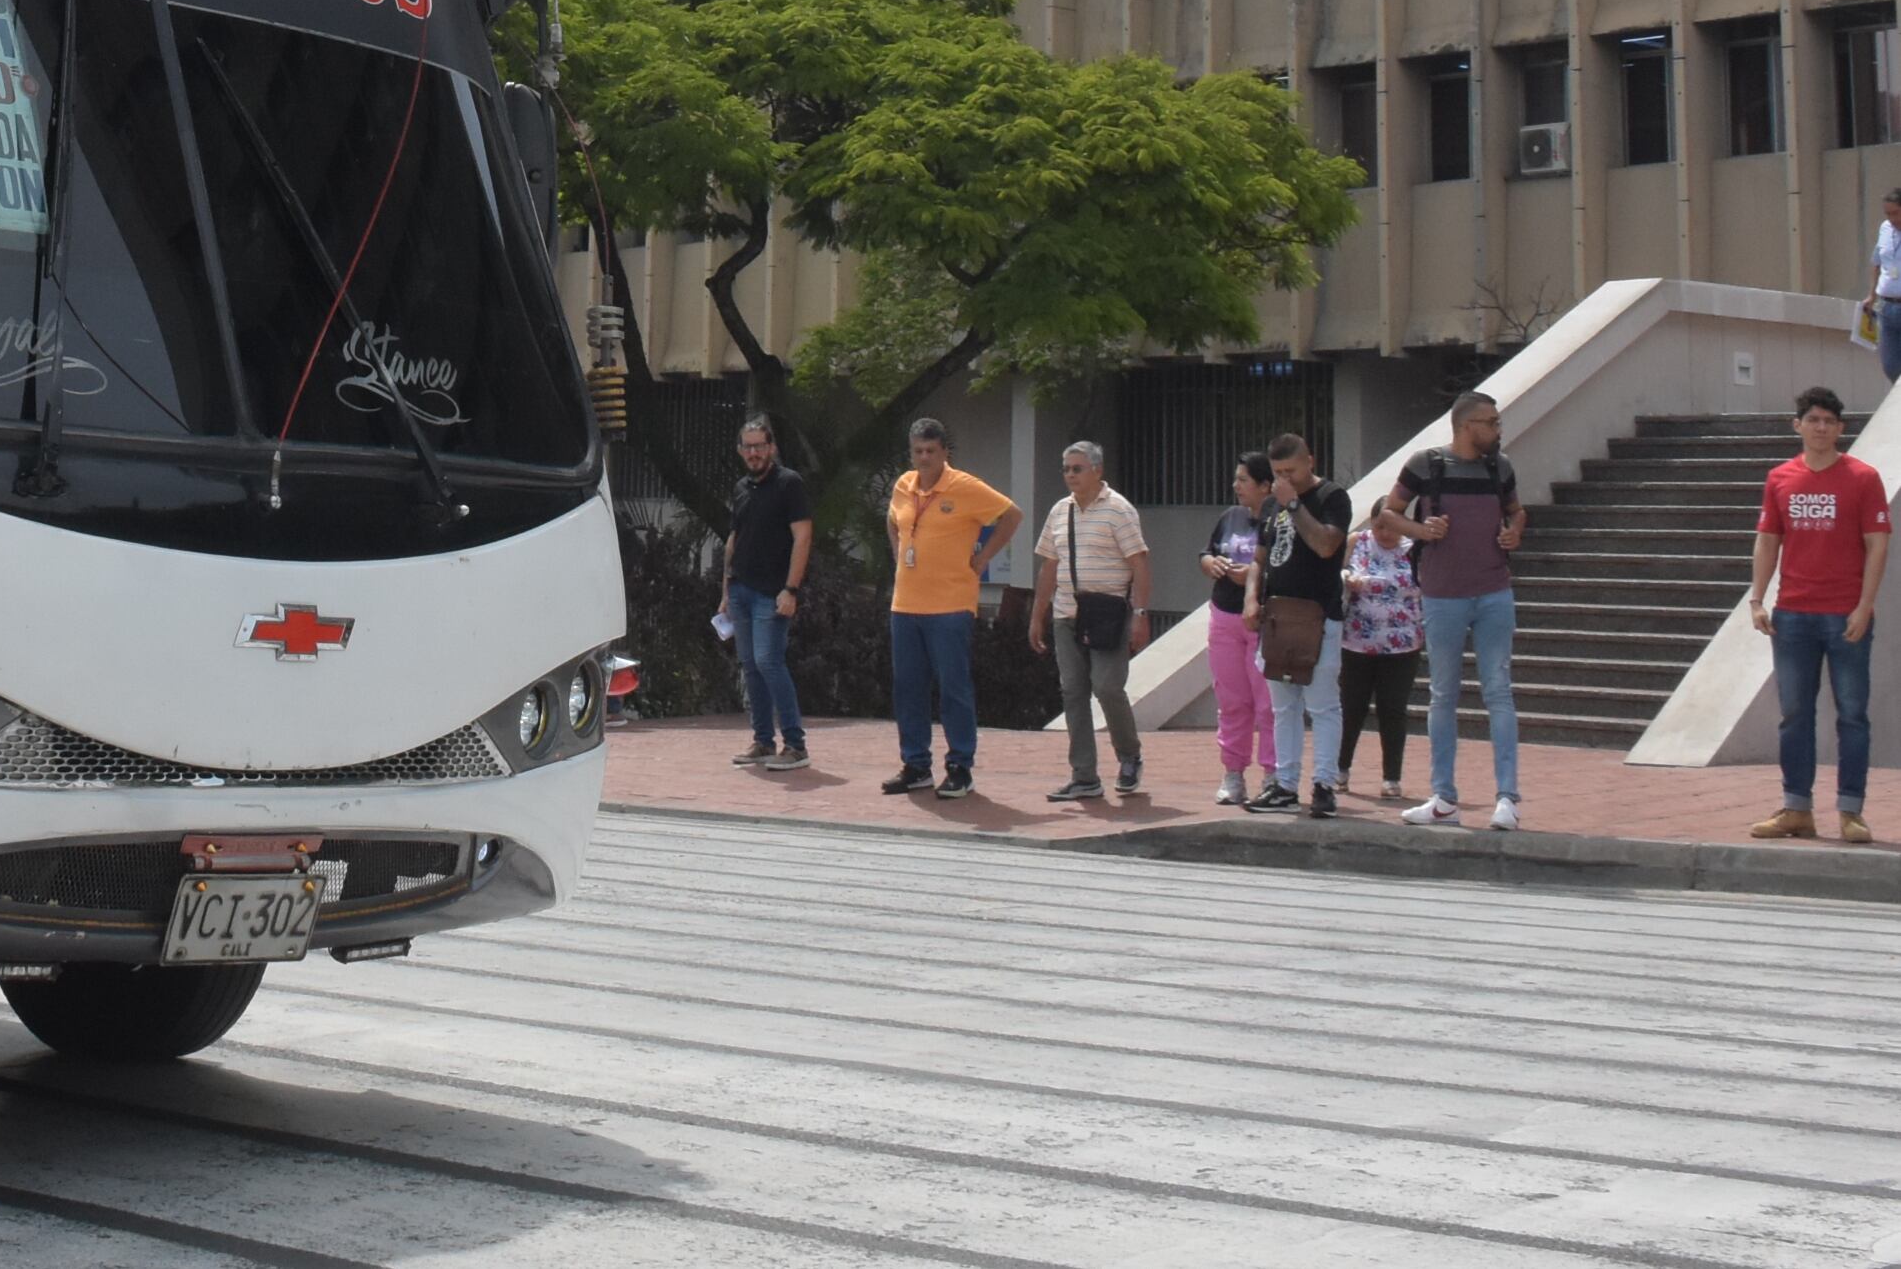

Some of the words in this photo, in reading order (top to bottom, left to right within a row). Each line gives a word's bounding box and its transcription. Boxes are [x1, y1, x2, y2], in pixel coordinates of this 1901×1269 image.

[339, 320, 459, 395] Stance
[1788, 493, 1836, 505] SOMOS
[1788, 504, 1836, 519] SIGA
